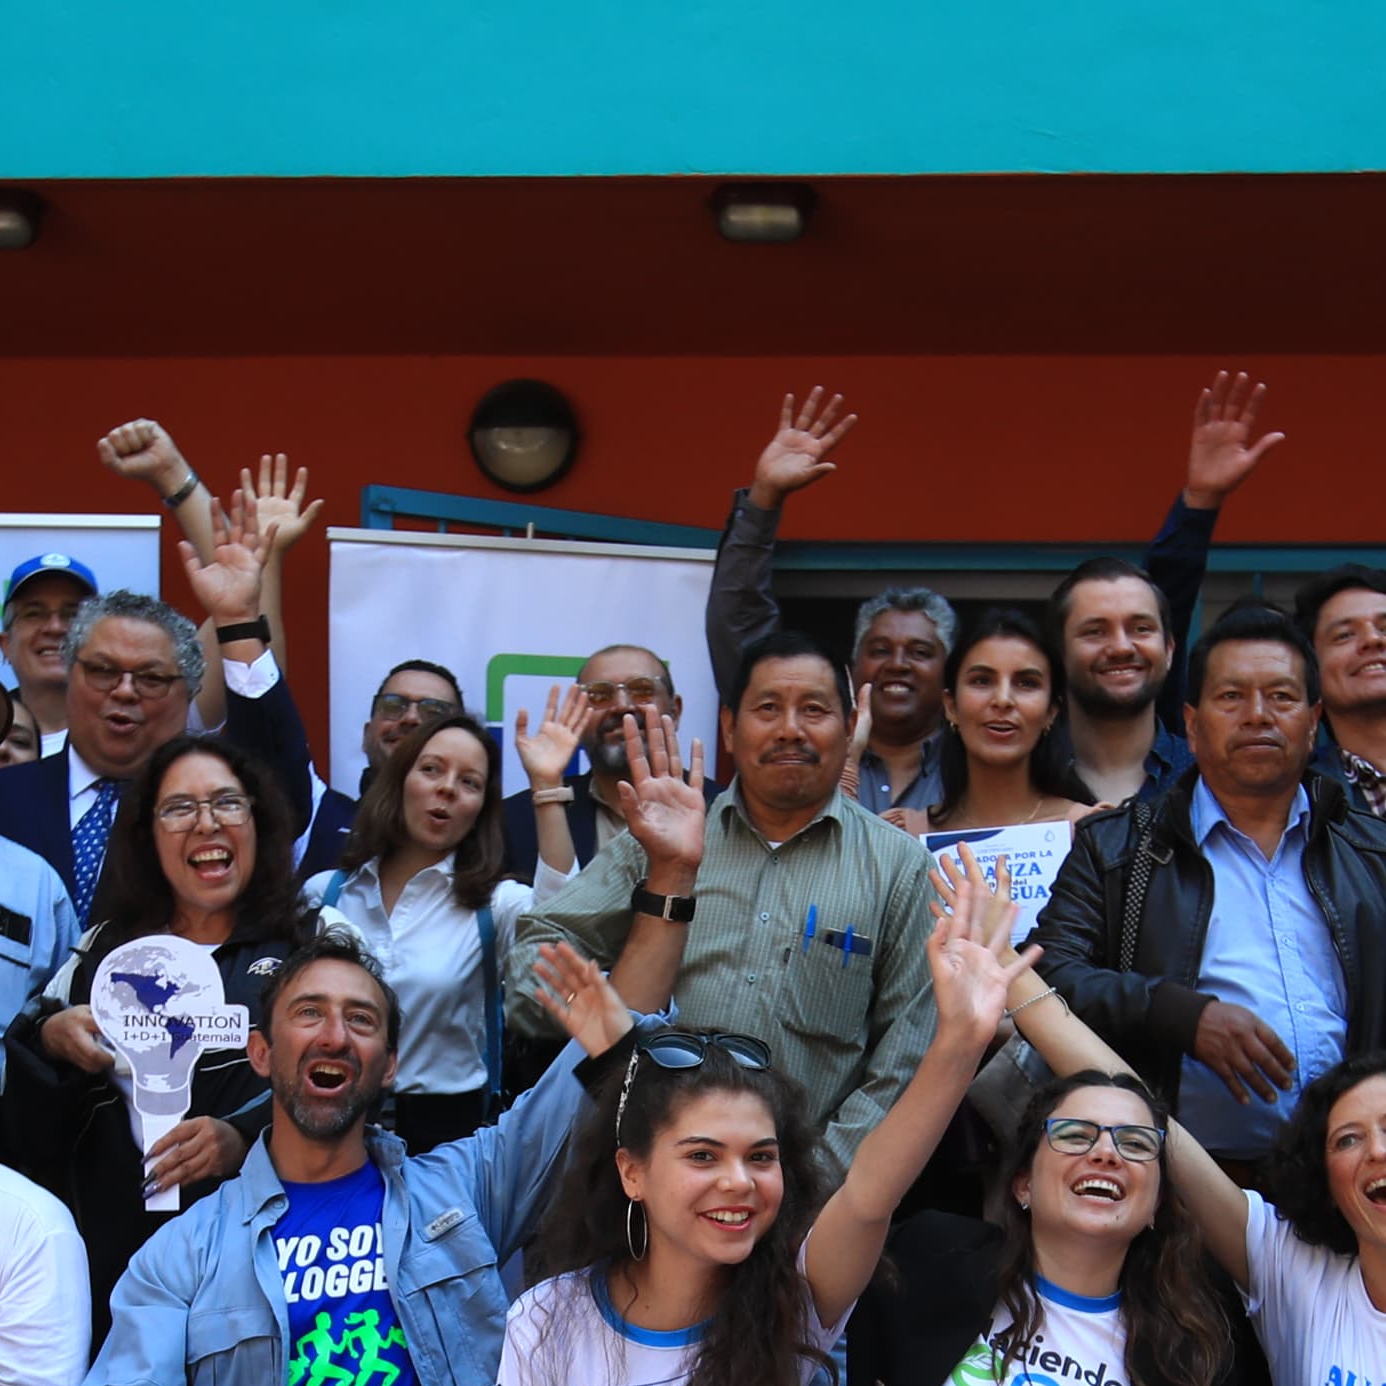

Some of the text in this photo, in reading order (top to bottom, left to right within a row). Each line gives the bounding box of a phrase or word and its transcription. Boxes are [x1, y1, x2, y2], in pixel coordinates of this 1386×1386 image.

[1015, 849, 1053, 860] POR LA
[123, 1013, 242, 1029] INNOVATION
[276, 1234, 322, 1271] YO
[283, 1257, 390, 1304] LOGGE
